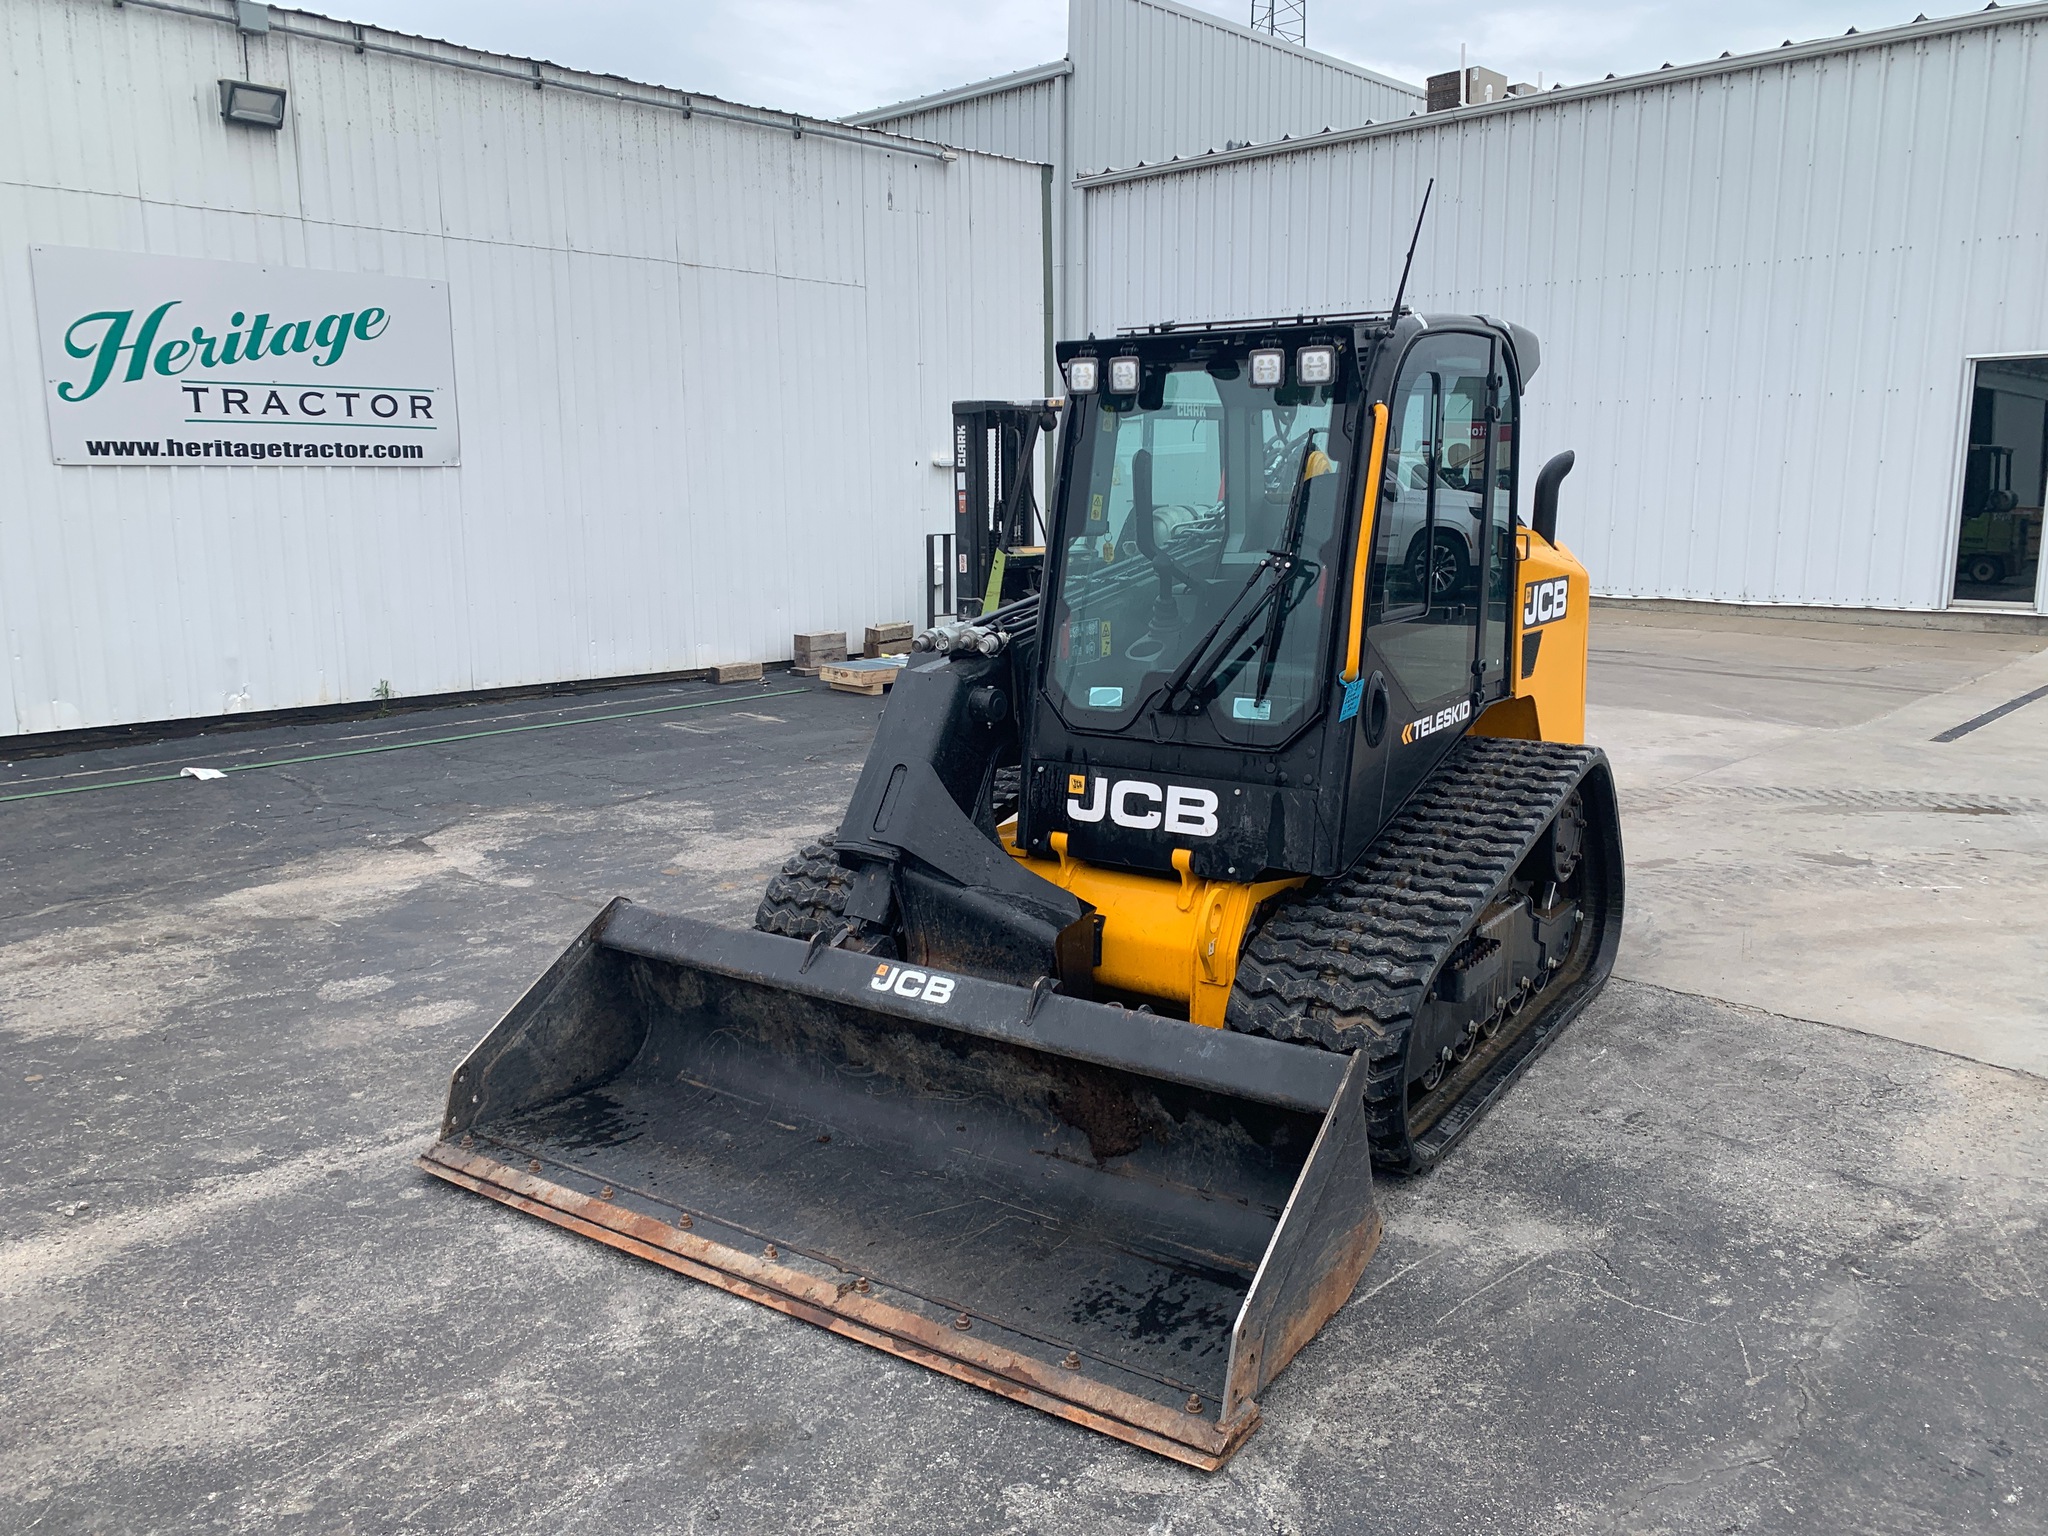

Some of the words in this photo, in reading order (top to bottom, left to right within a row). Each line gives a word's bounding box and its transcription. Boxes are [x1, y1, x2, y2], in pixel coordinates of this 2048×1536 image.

[57, 301, 391, 402] Heritage
[182, 386, 434, 419] TRACTOR
[1176, 404, 1207, 417] CLARK
[86, 438, 424, 460] www.heritagetractor.com
[957, 425, 966, 467] CLARK
[1524, 580, 1568, 625] JCB
[1413, 700, 1470, 740] TELESKID
[1067, 777, 1219, 837] JCB
[871, 967, 956, 1004] JCB
